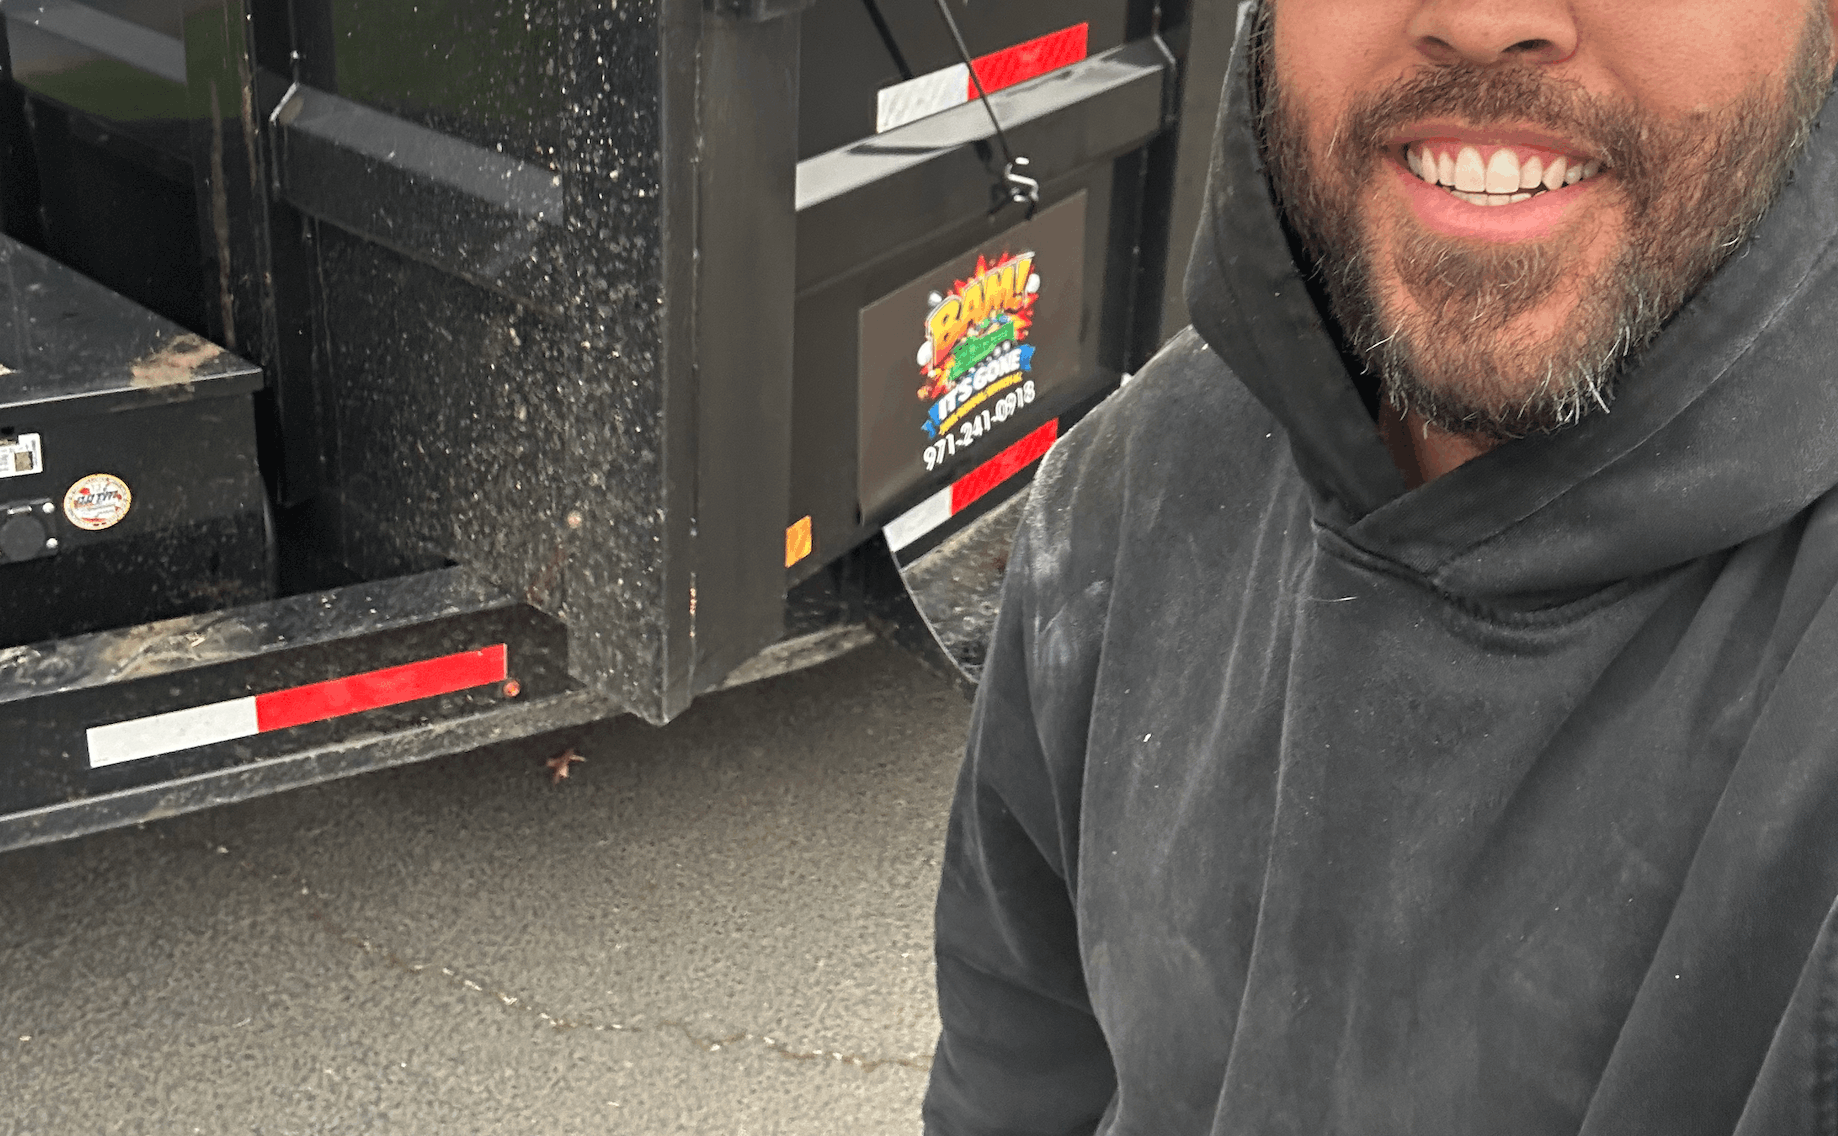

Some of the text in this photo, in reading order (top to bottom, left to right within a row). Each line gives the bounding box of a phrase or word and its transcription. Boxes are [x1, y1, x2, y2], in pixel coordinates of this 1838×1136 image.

[926, 252, 1036, 368] BAM!
[973, 348, 1022, 390] GONE
[923, 380, 1036, 471] 971-241-0918
